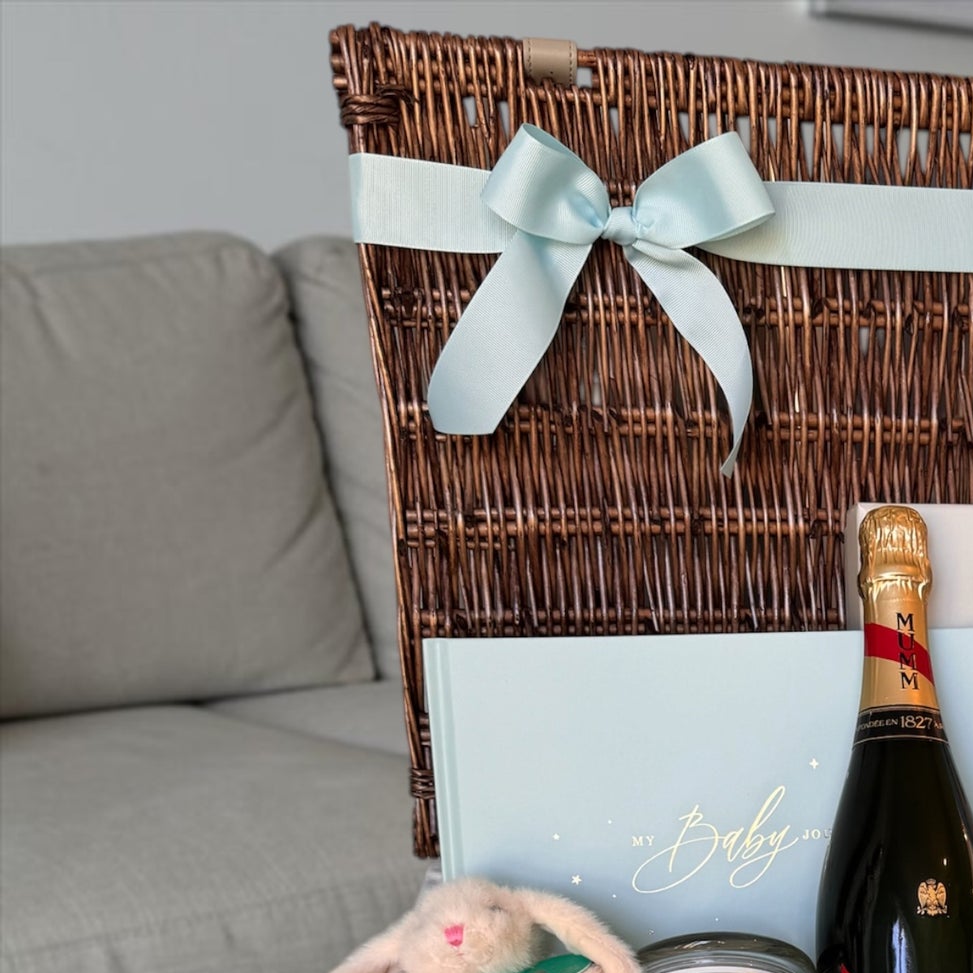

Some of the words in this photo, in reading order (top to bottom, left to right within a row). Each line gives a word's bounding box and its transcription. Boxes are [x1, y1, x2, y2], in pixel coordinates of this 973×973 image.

[896, 613, 919, 690] MUMM
[901, 715, 932, 729] 1827
[632, 785, 799, 893] Baby
[632, 836, 654, 847] MY
